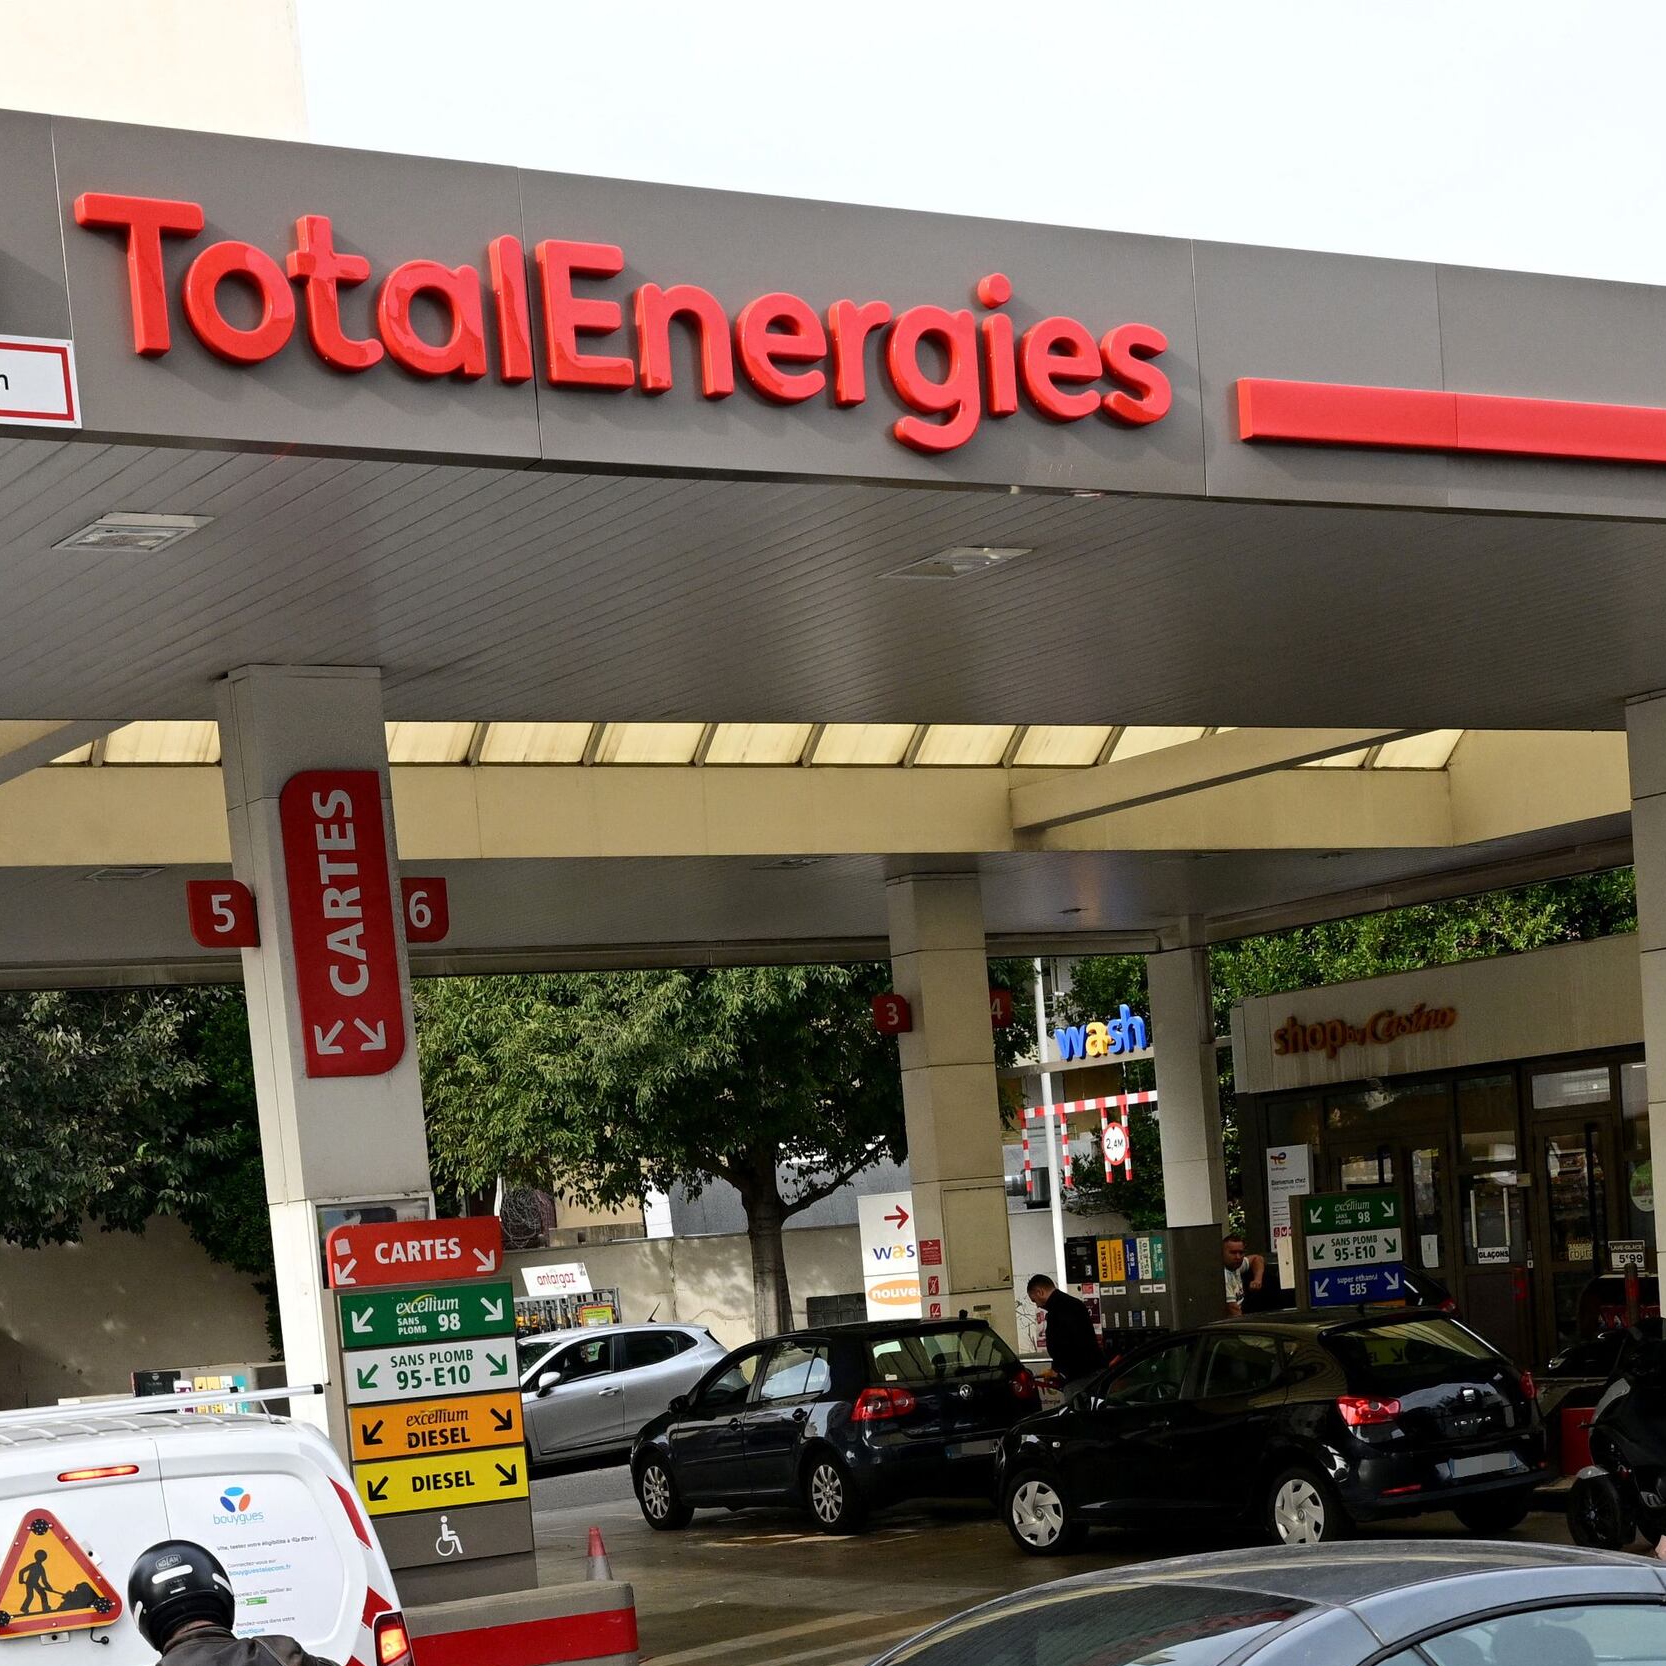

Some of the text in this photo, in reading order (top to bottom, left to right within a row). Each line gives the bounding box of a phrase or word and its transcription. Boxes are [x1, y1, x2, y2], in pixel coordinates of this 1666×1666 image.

[73, 191, 1171, 455] TotalEnergies
[312, 789, 370, 997] CARTES
[210, 893, 236, 934] 5
[408, 890, 432, 929] 6
[886, 1002, 900, 1026] 3
[990, 998, 1004, 1020] 4
[1053, 1003, 1147, 1062] wash
[1273, 1015, 1346, 1060] shop
[1366, 1001, 1458, 1045] Casino
[1105, 1137, 1125, 1150] 2,4M
[1334, 1200, 1370, 1212] excellium
[1357, 1211, 1372, 1224] 98
[1331, 1234, 1378, 1248] SANS PLOMB
[374, 1237, 462, 1265] CARTES
[1334, 1244, 1377, 1262] 95-E10
[1478, 1250, 1510, 1260] GLAÇONS
[537, 1271, 577, 1289] antargaz
[1337, 1276, 1354, 1285] super
[1349, 1283, 1367, 1296] E85
[395, 1296, 460, 1315] excellium
[396, 1312, 462, 1333] SANS 98
[398, 1323, 428, 1336] PLOMB
[390, 1348, 474, 1368] SANS PLOMB
[396, 1364, 471, 1391] 95-E10
[406, 1408, 469, 1427] excellium
[407, 1427, 471, 1449] DIESEL
[411, 1470, 475, 1493] DIESEL
[213, 1510, 264, 1525] bouygues
[157, 1555, 181, 1568] NOLAN
